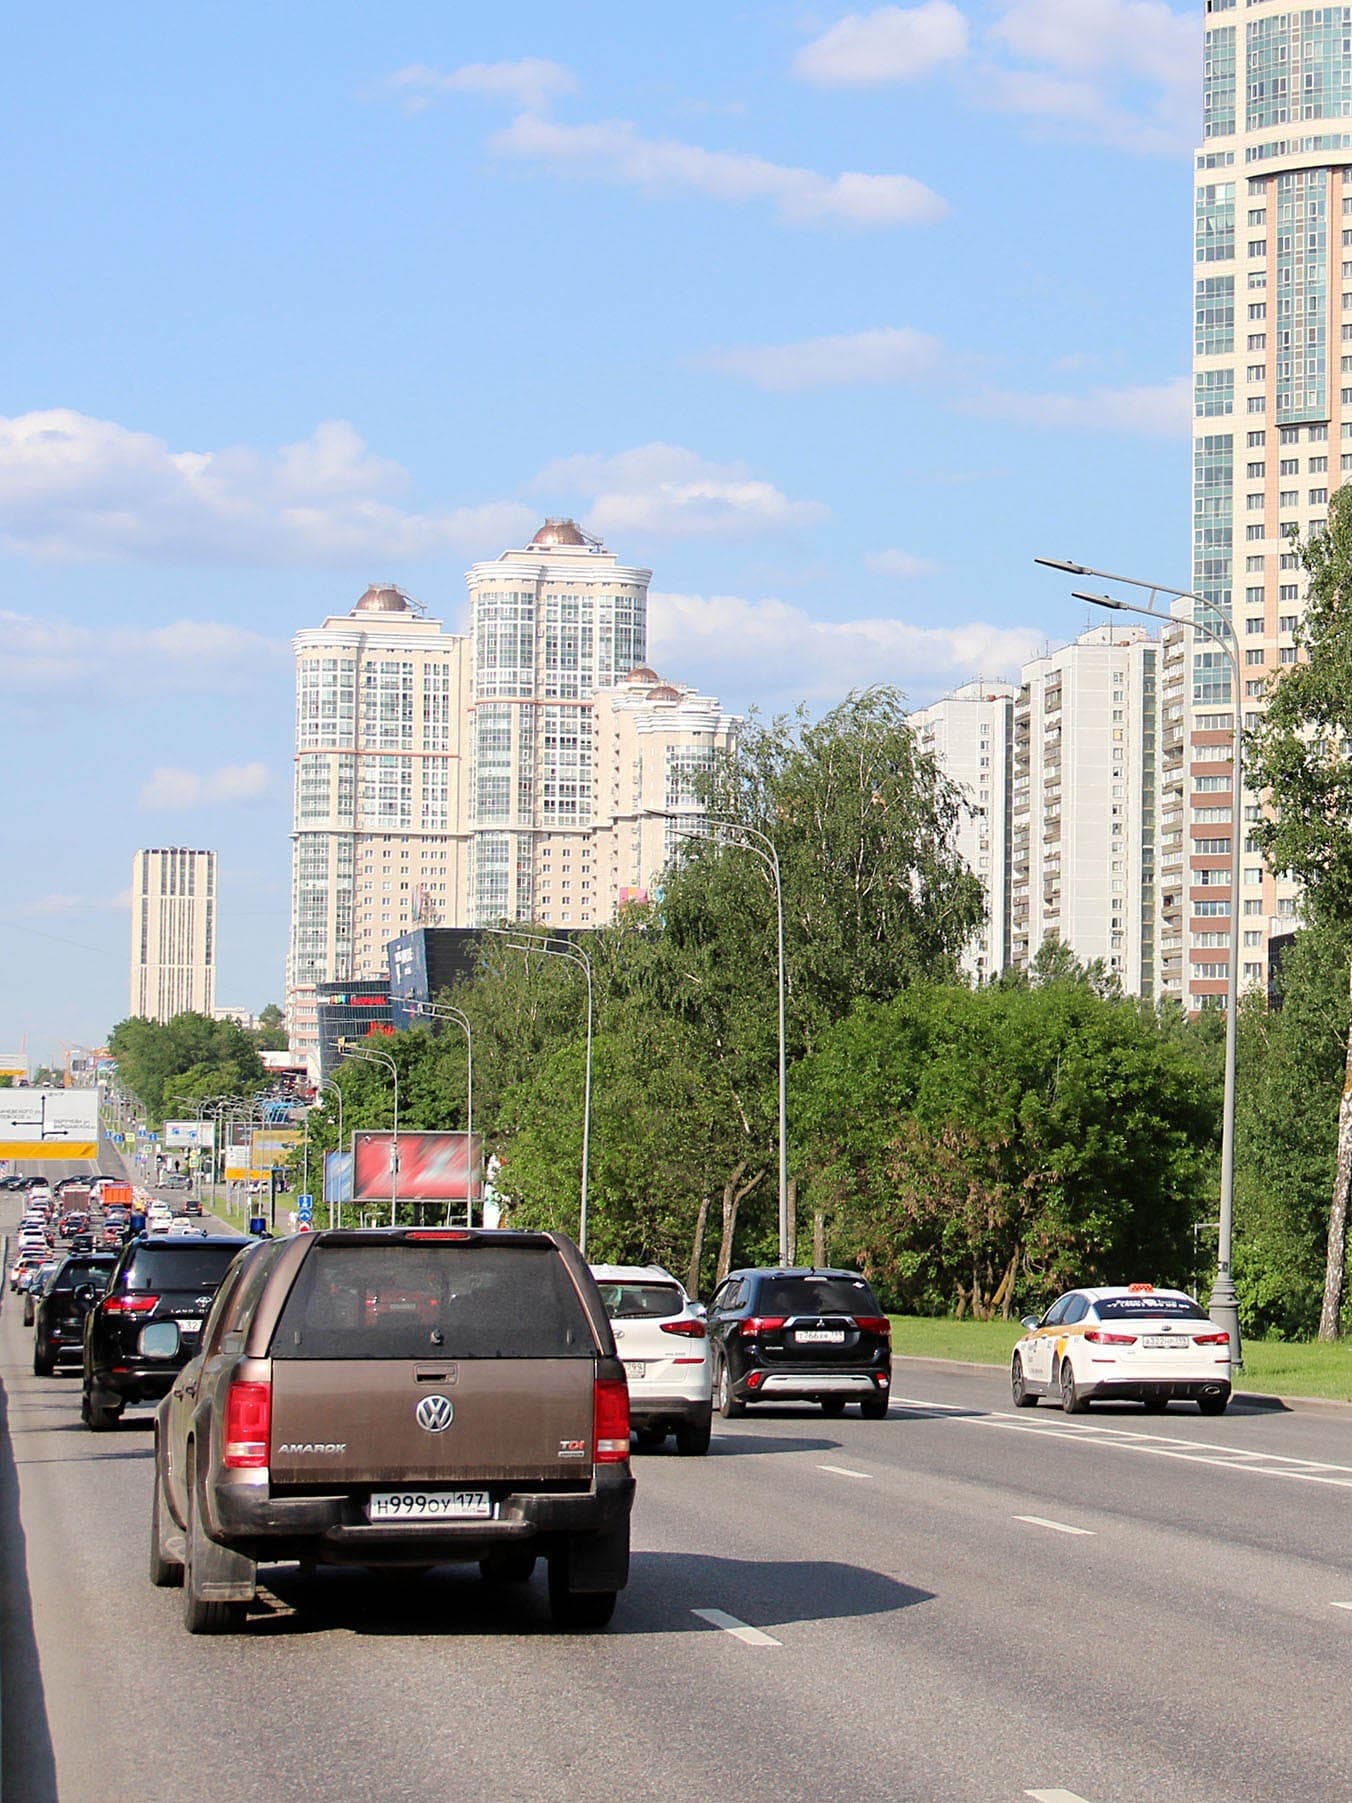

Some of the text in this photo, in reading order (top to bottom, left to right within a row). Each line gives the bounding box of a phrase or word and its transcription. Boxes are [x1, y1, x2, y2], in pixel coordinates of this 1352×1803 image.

[278, 1442, 347, 1455] AMAROK
[559, 1440, 586, 1450] TDI
[377, 1493, 485, 1515] Н999ОУ 177
